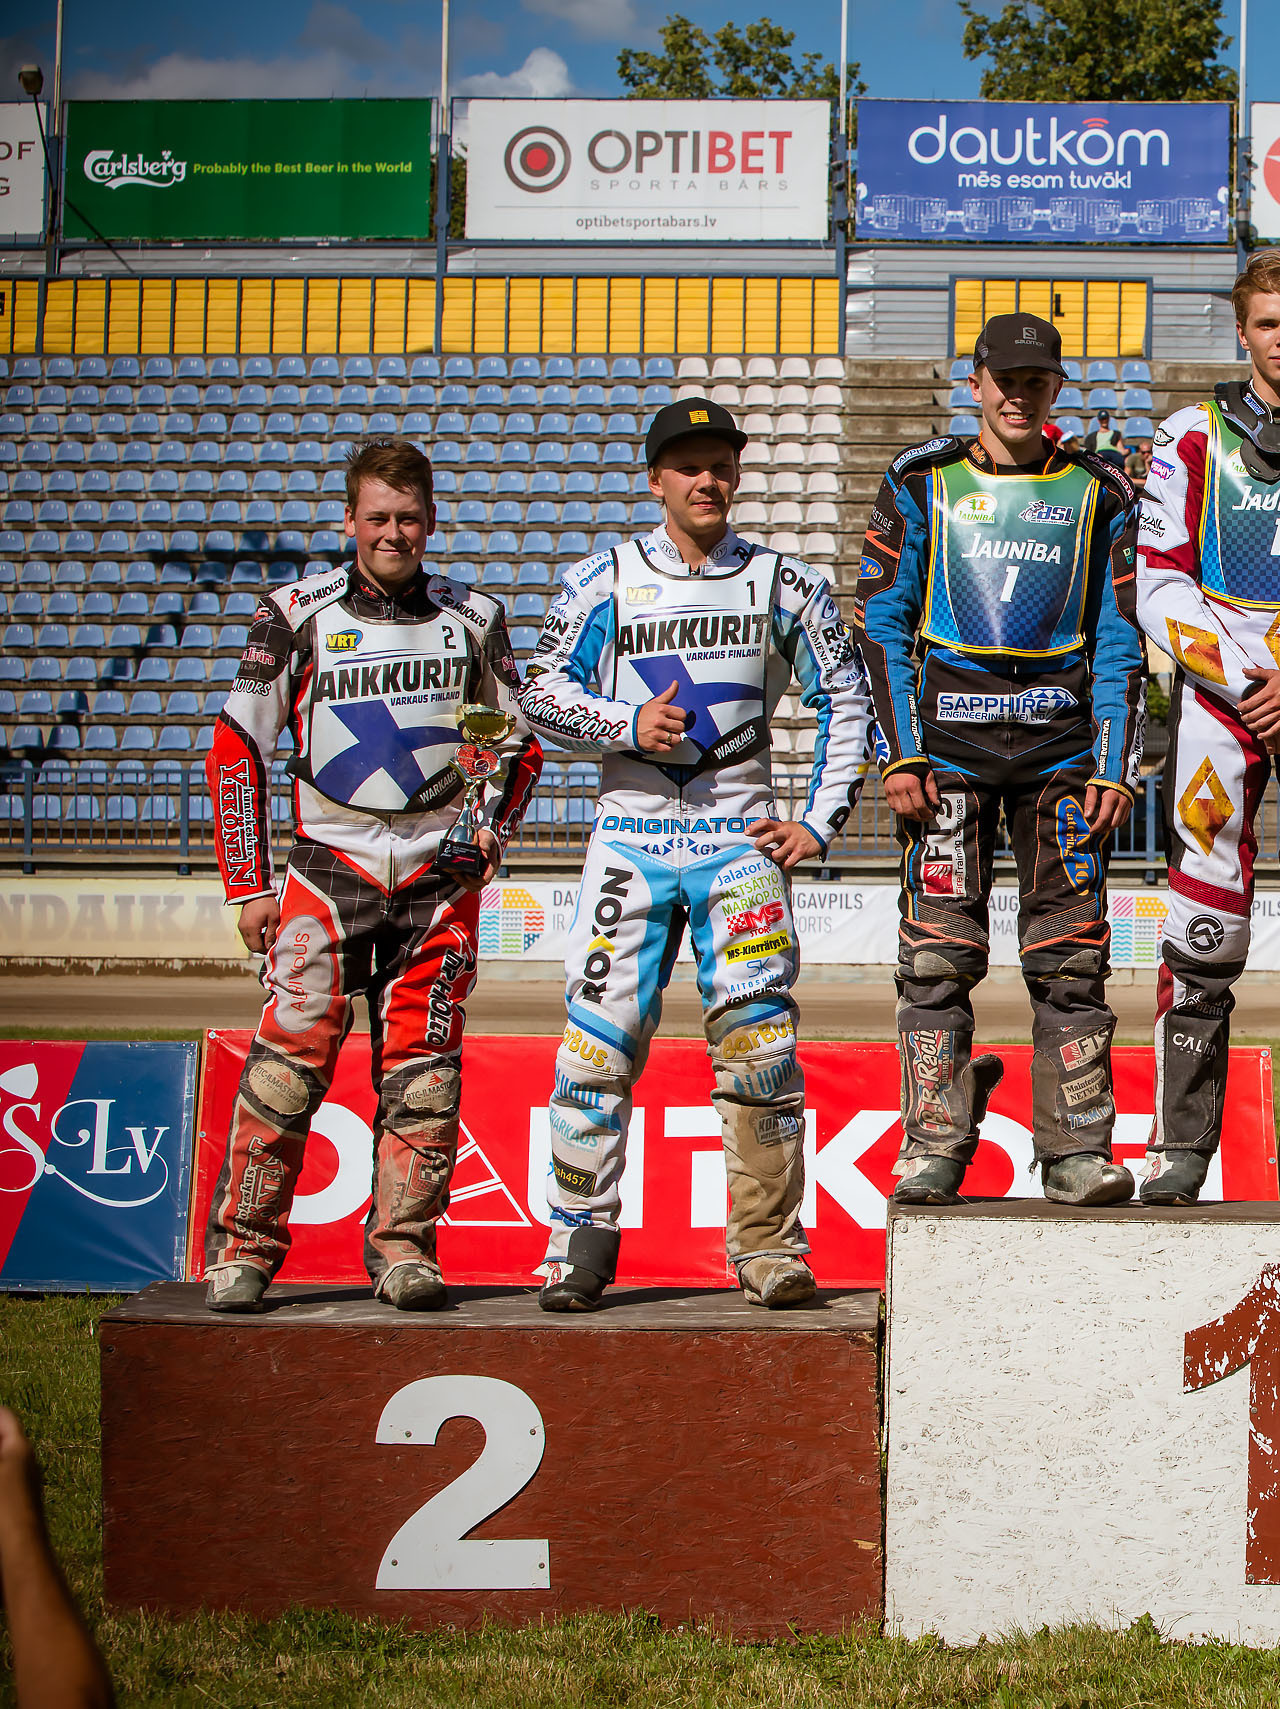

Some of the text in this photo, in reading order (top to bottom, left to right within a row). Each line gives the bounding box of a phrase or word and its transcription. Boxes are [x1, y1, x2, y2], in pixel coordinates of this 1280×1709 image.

[587, 129, 793, 174] OPTIBET
[84, 150, 187, 190] Carlsberg
[193, 161, 412, 176] Probably the Best Beer in the World
[958, 170, 1132, 189] mēs esam tuvāk!
[590, 179, 698, 191] SPORTA
[575, 214, 717, 230] optibetsportabars.lv
[961, 533, 1061, 564] JAUNĪBA
[626, 587, 657, 603] VRT
[746, 581, 756, 606] 1
[1000, 566, 1020, 602] 1
[326, 634, 357, 648] VRT
[442, 626, 456, 649] 2
[616, 613, 771, 657] ANKKURIT
[686, 648, 761, 662] VARKAUS FINLAND
[314, 657, 470, 702] ANKKURIT
[390, 691, 460, 706] VARKAUS FINLAND
[939, 695, 1050, 713] SAPPHIRE
[939, 711, 1005, 721] ENGINEERING
[714, 725, 756, 760] WARKAUS
[420, 770, 458, 804] WARKAUS
[242, 787, 258, 859] kuntokeskus
[717, 862, 763, 887] Jalator
[720, 872, 779, 902] METSÄTYÖ
[722, 891, 770, 916] MARKOP
[375, 1374, 550, 1589] 2
